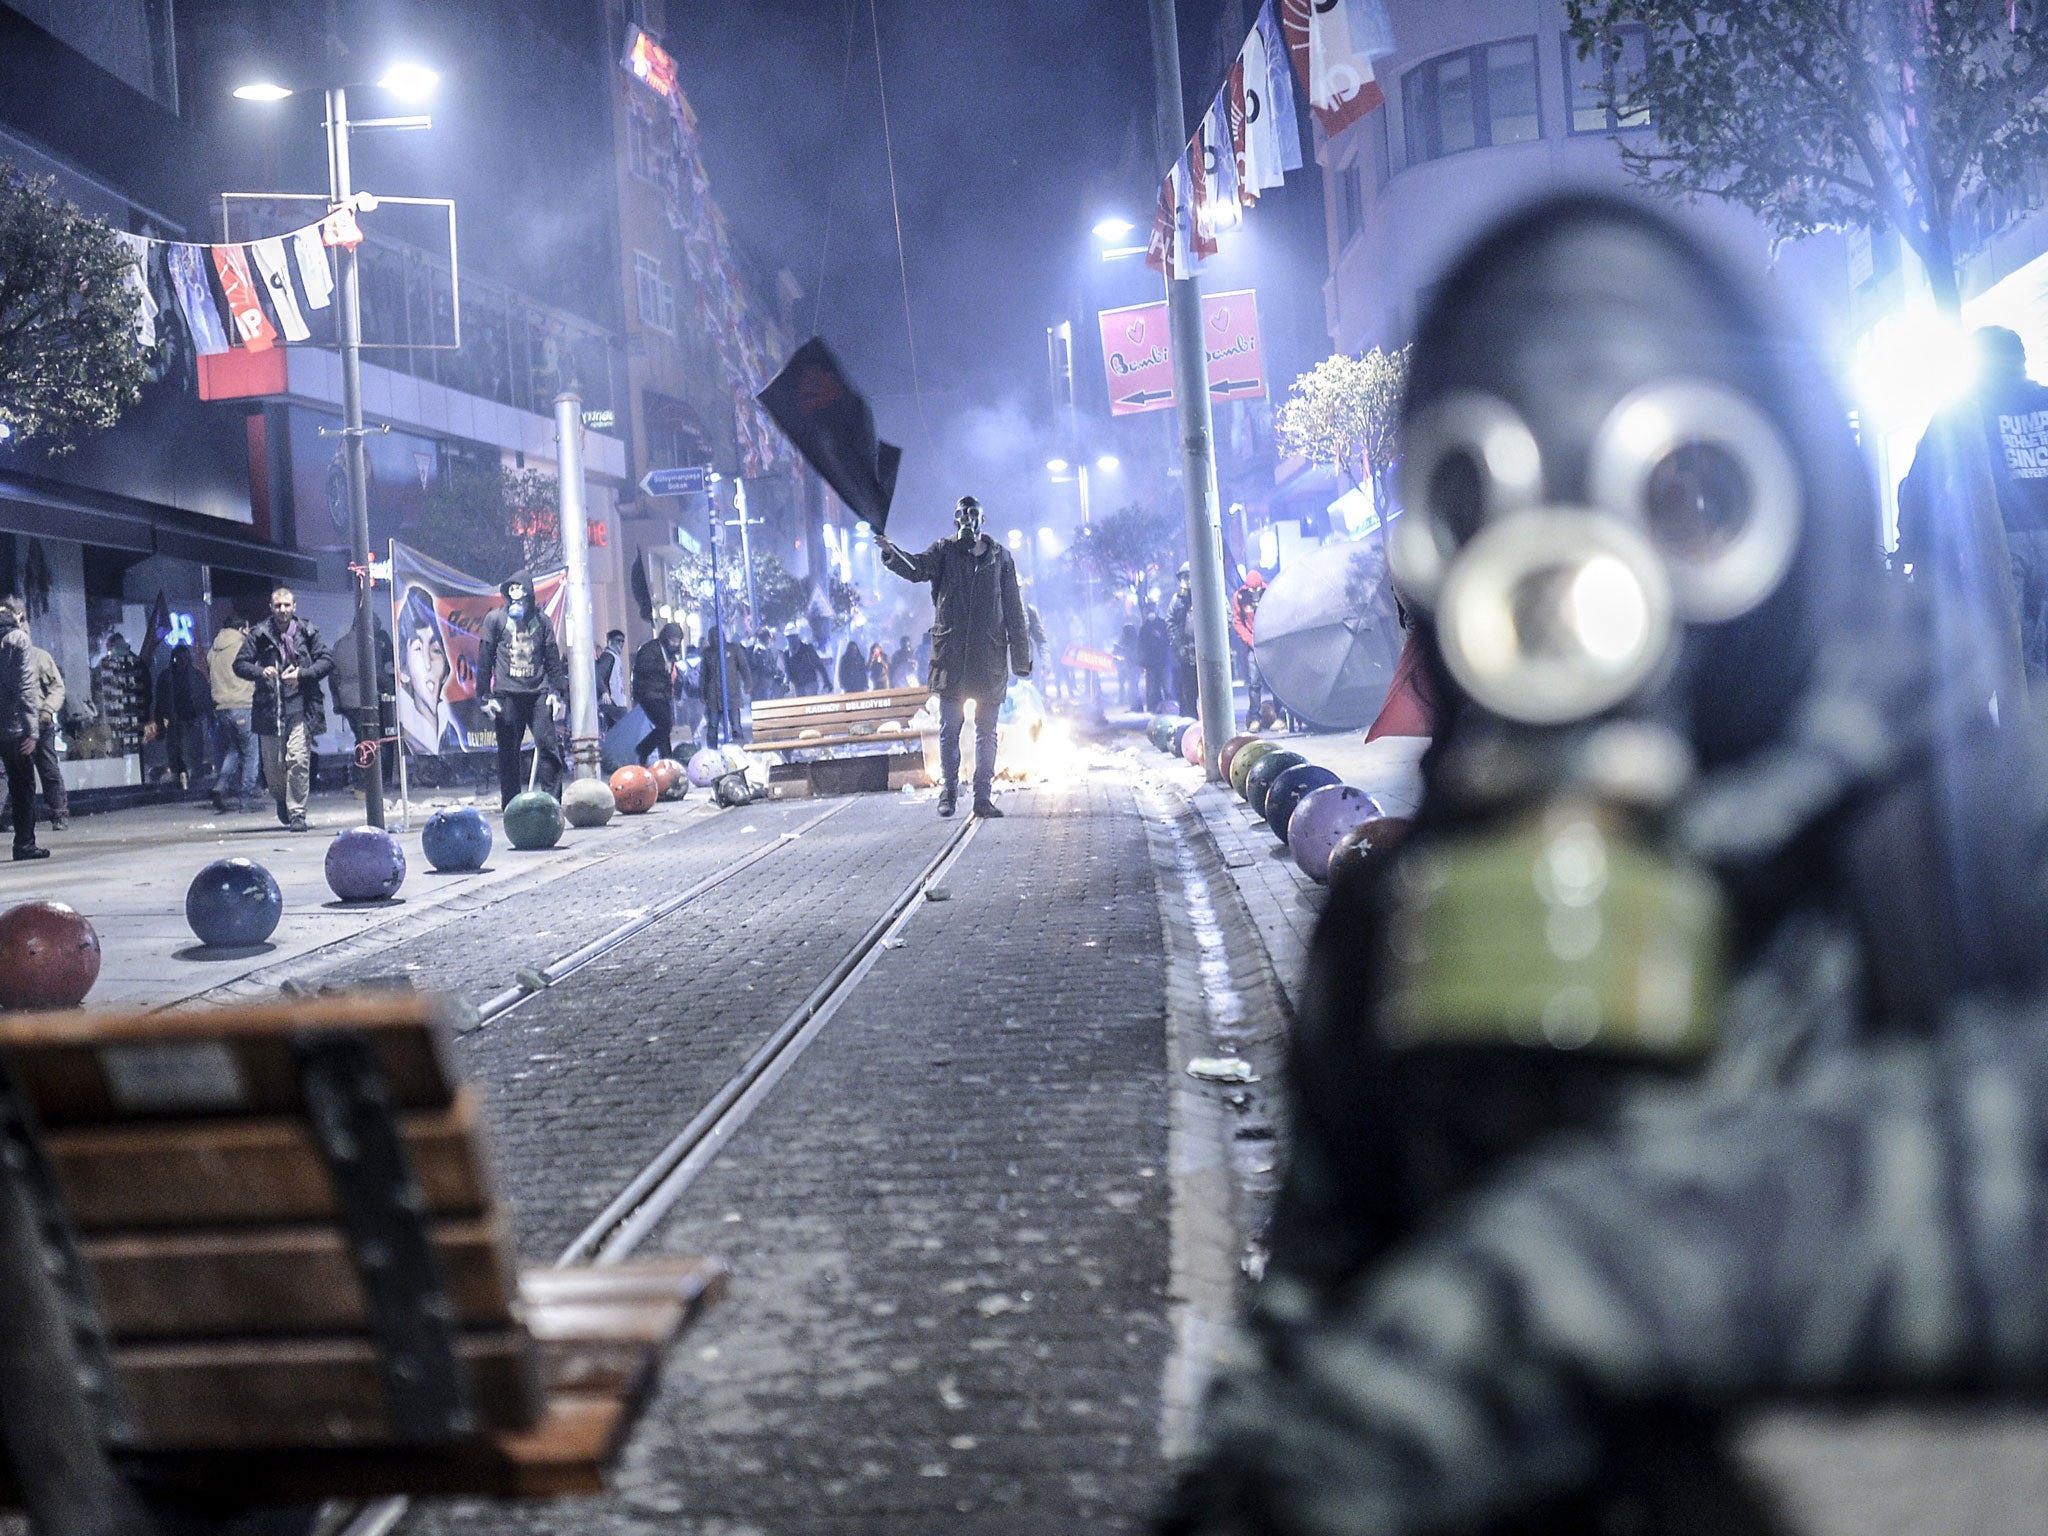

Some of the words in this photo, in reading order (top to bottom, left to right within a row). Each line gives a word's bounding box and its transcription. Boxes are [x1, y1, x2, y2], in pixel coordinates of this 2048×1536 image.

[1110, 347, 1168, 375] Bambi
[2004, 446, 2048, 469] SINC
[467, 728, 498, 747] DEVRİMC
